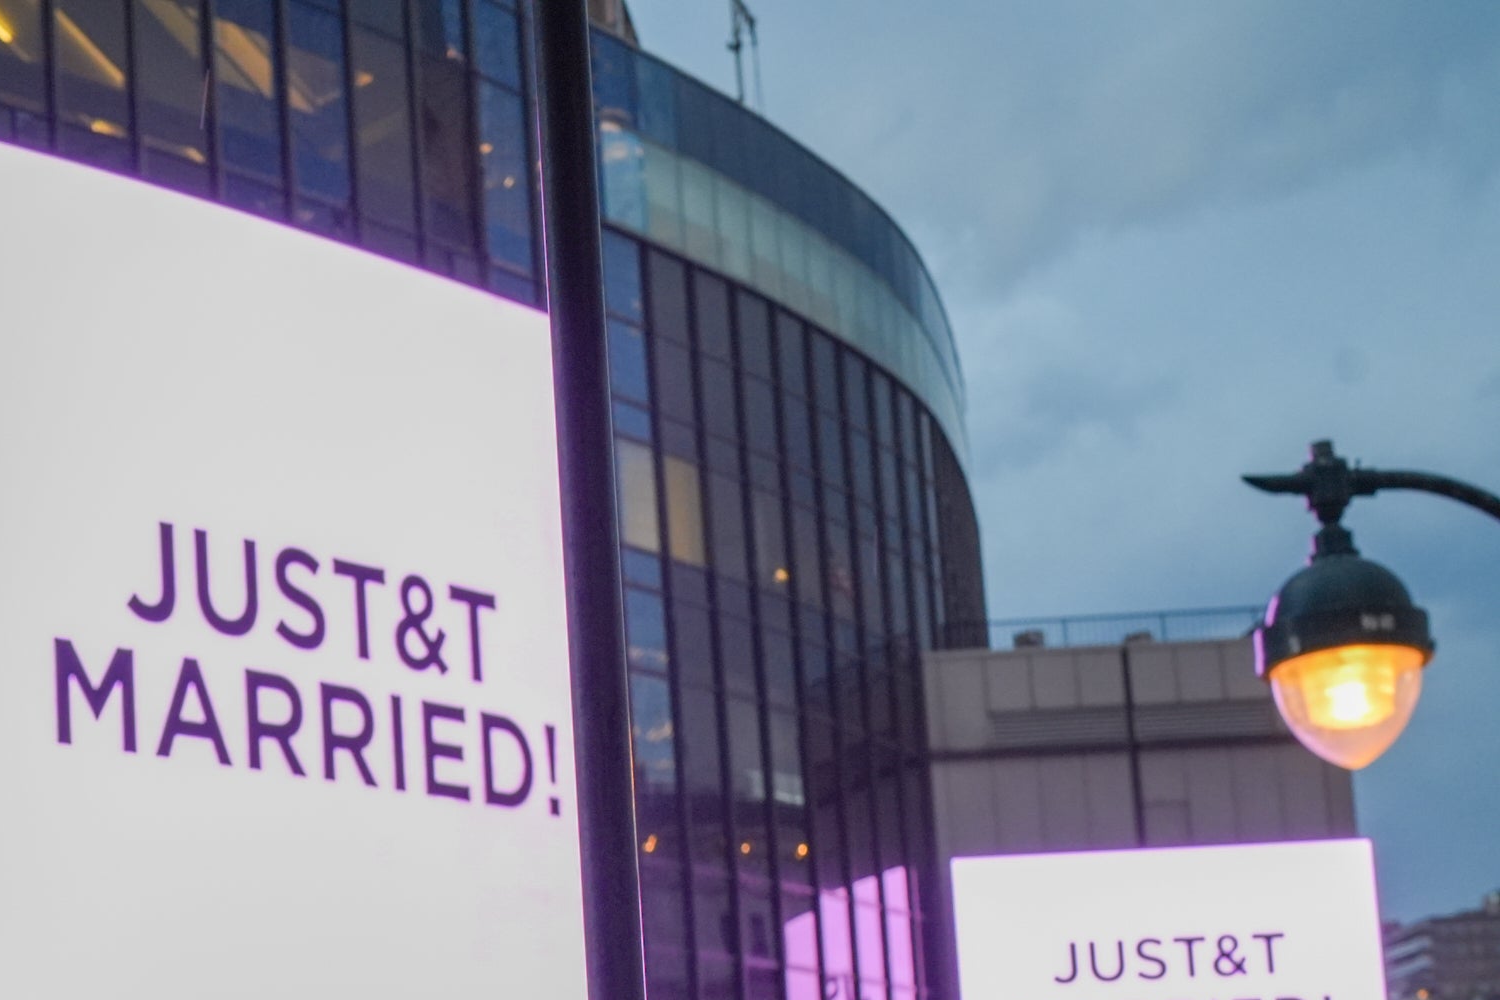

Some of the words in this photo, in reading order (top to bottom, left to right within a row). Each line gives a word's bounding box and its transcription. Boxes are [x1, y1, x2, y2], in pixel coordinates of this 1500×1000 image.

[126, 520, 498, 684] JUST&T
[53, 636, 562, 818] MARRIED!
[1053, 931, 1285, 984] JUST&T
